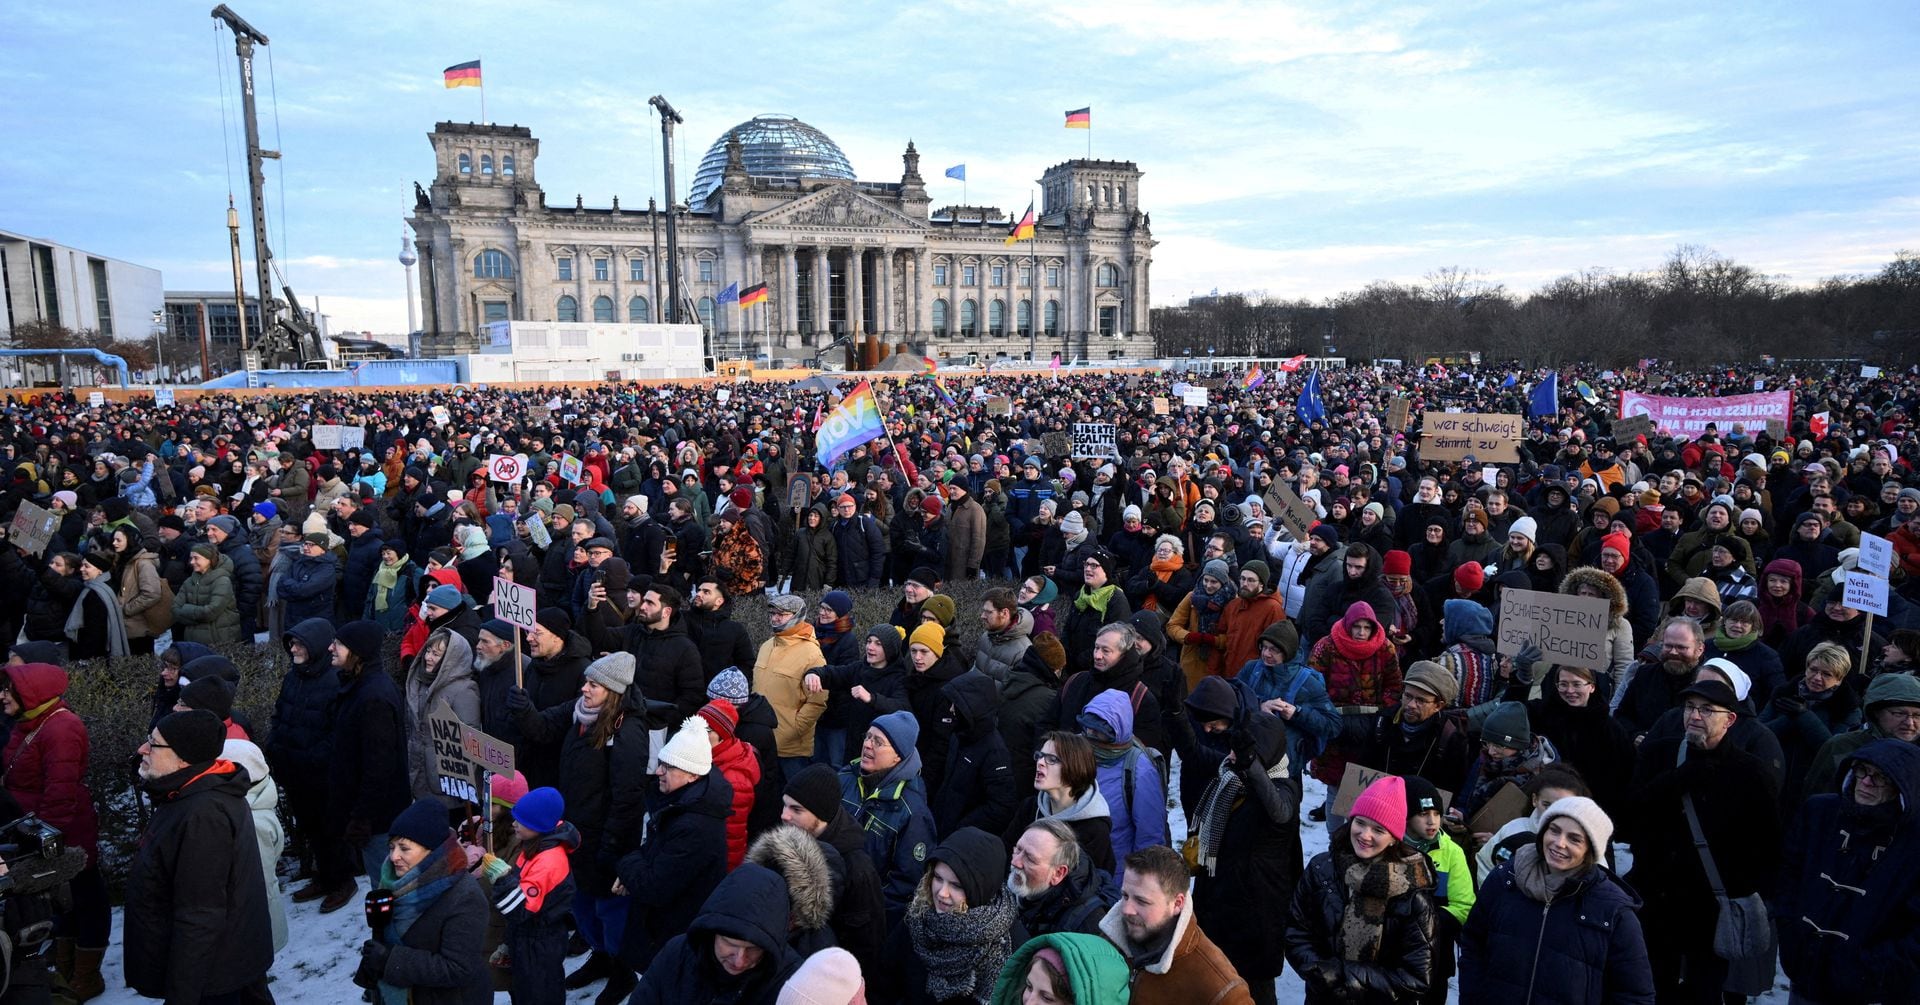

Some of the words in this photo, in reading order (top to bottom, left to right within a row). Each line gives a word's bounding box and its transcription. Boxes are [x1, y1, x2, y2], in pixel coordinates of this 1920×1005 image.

[1073, 424, 1114, 434] LIBERTE
[1433, 420, 1459, 430] wer
[1462, 418, 1516, 438] schweigt
[1073, 434, 1114, 443] EGALITE
[1434, 434, 1472, 449] stimmt
[1478, 441, 1498, 450] zu
[1869, 541, 1882, 553] Blau
[1848, 578, 1869, 589] Nein
[497, 579, 519, 603] NO
[1858, 589, 1873, 599] Hass
[498, 599, 534, 627] NAZIS
[434, 740, 471, 763] RAU
